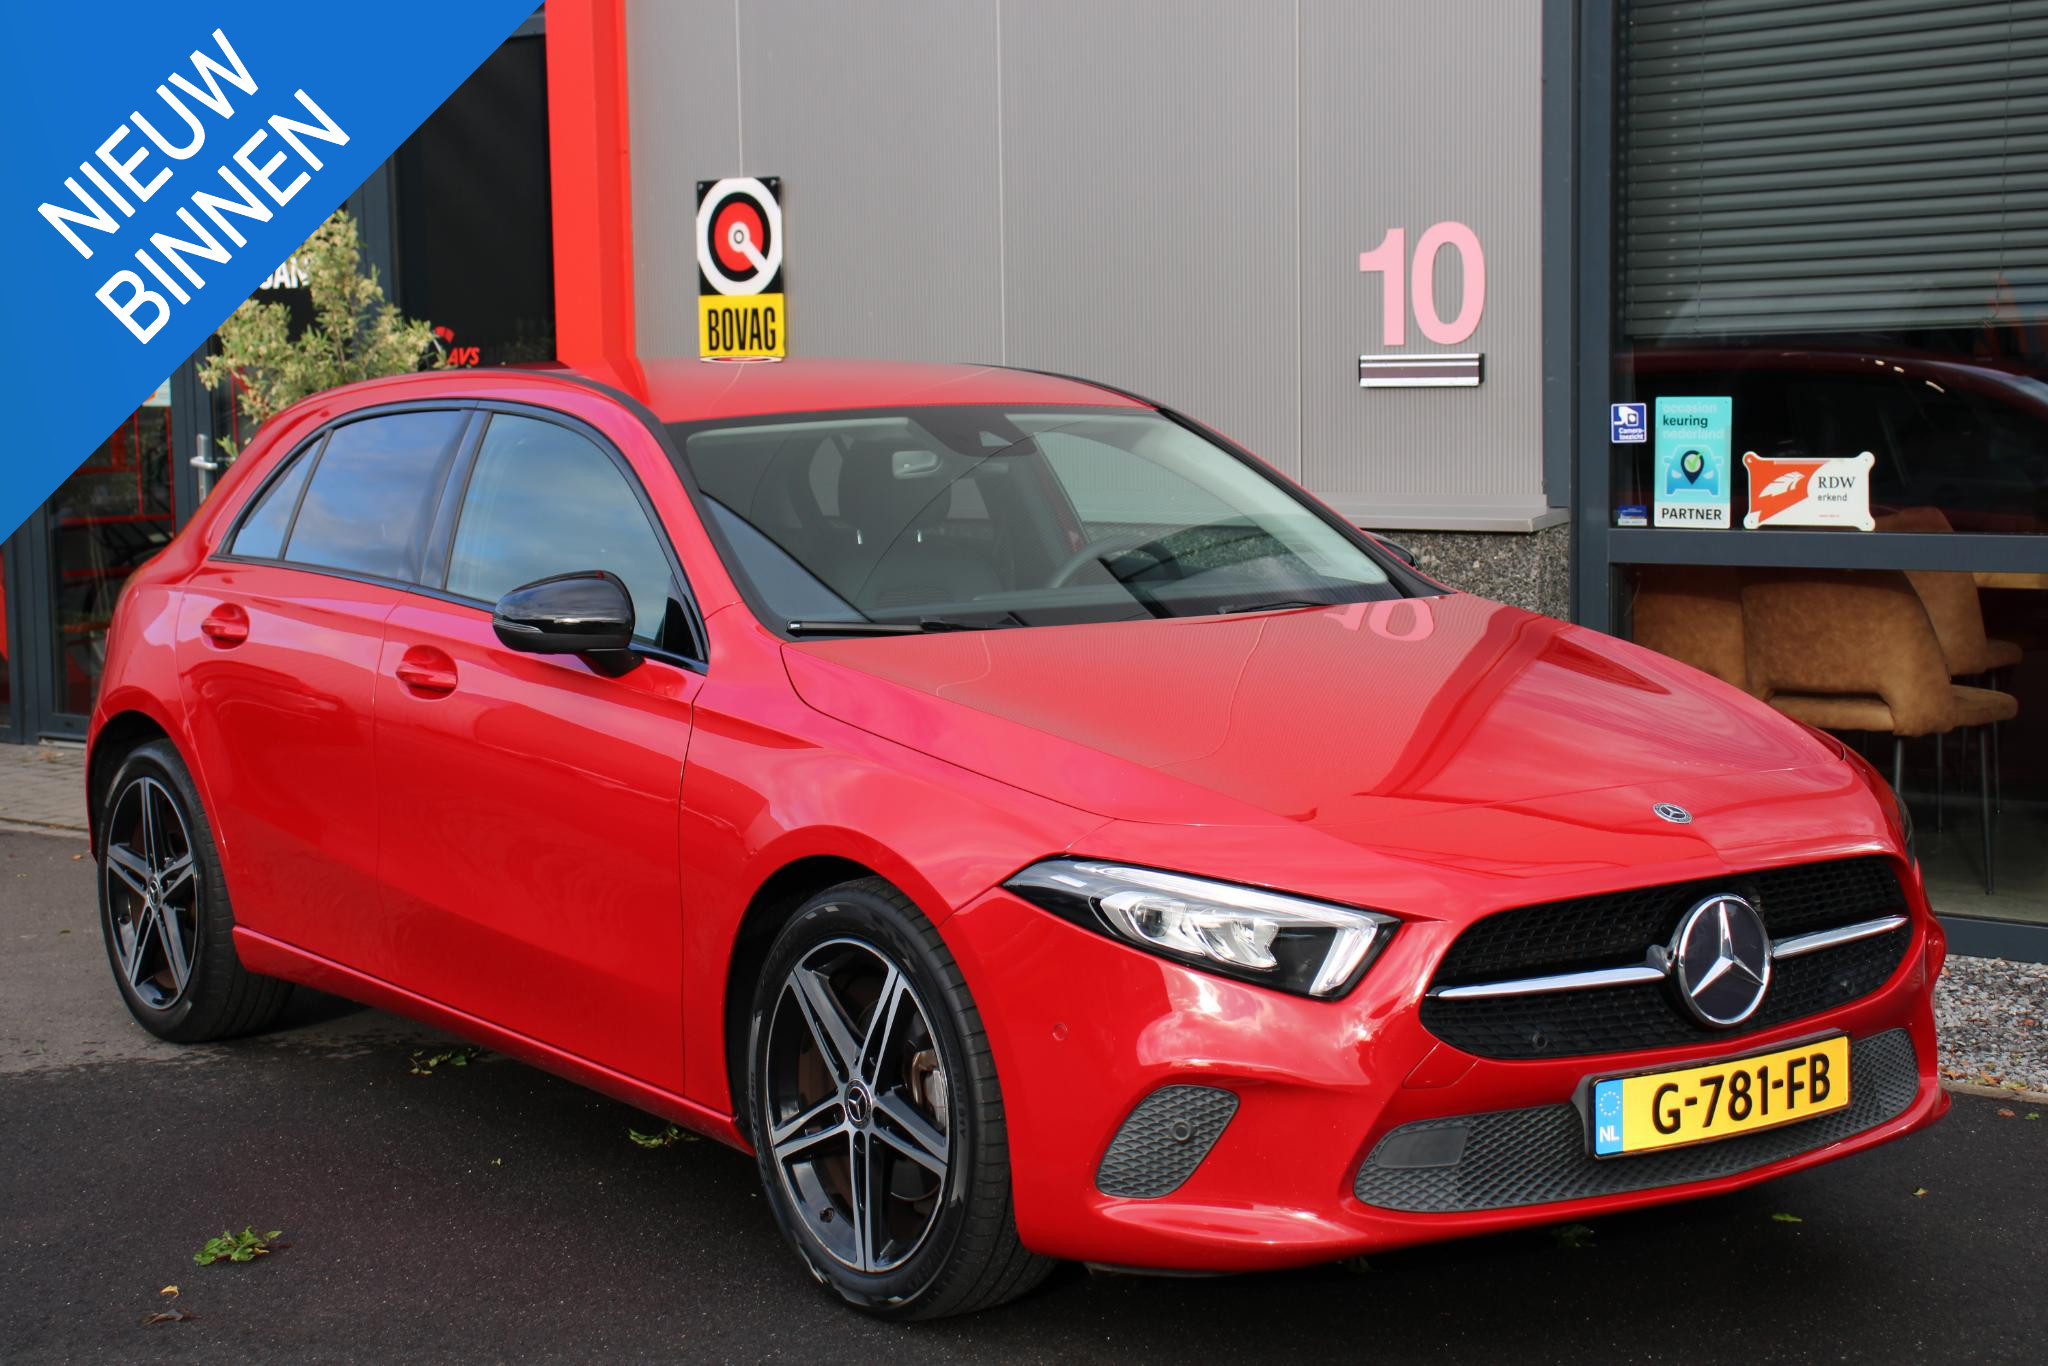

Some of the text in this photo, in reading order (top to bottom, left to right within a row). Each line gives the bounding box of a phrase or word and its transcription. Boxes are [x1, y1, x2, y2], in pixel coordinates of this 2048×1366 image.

[1360, 221, 1486, 346] 10
[707, 307, 776, 351] BOVAG
[1662, 414, 1708, 429] keuring
[1817, 476, 1856, 488] RDW
[1817, 493, 1848, 501] erkend
[1661, 507, 1722, 521] PARTNER
[1652, 1052, 1831, 1135] G-781-FB
[1599, 1125, 1620, 1143] NL
